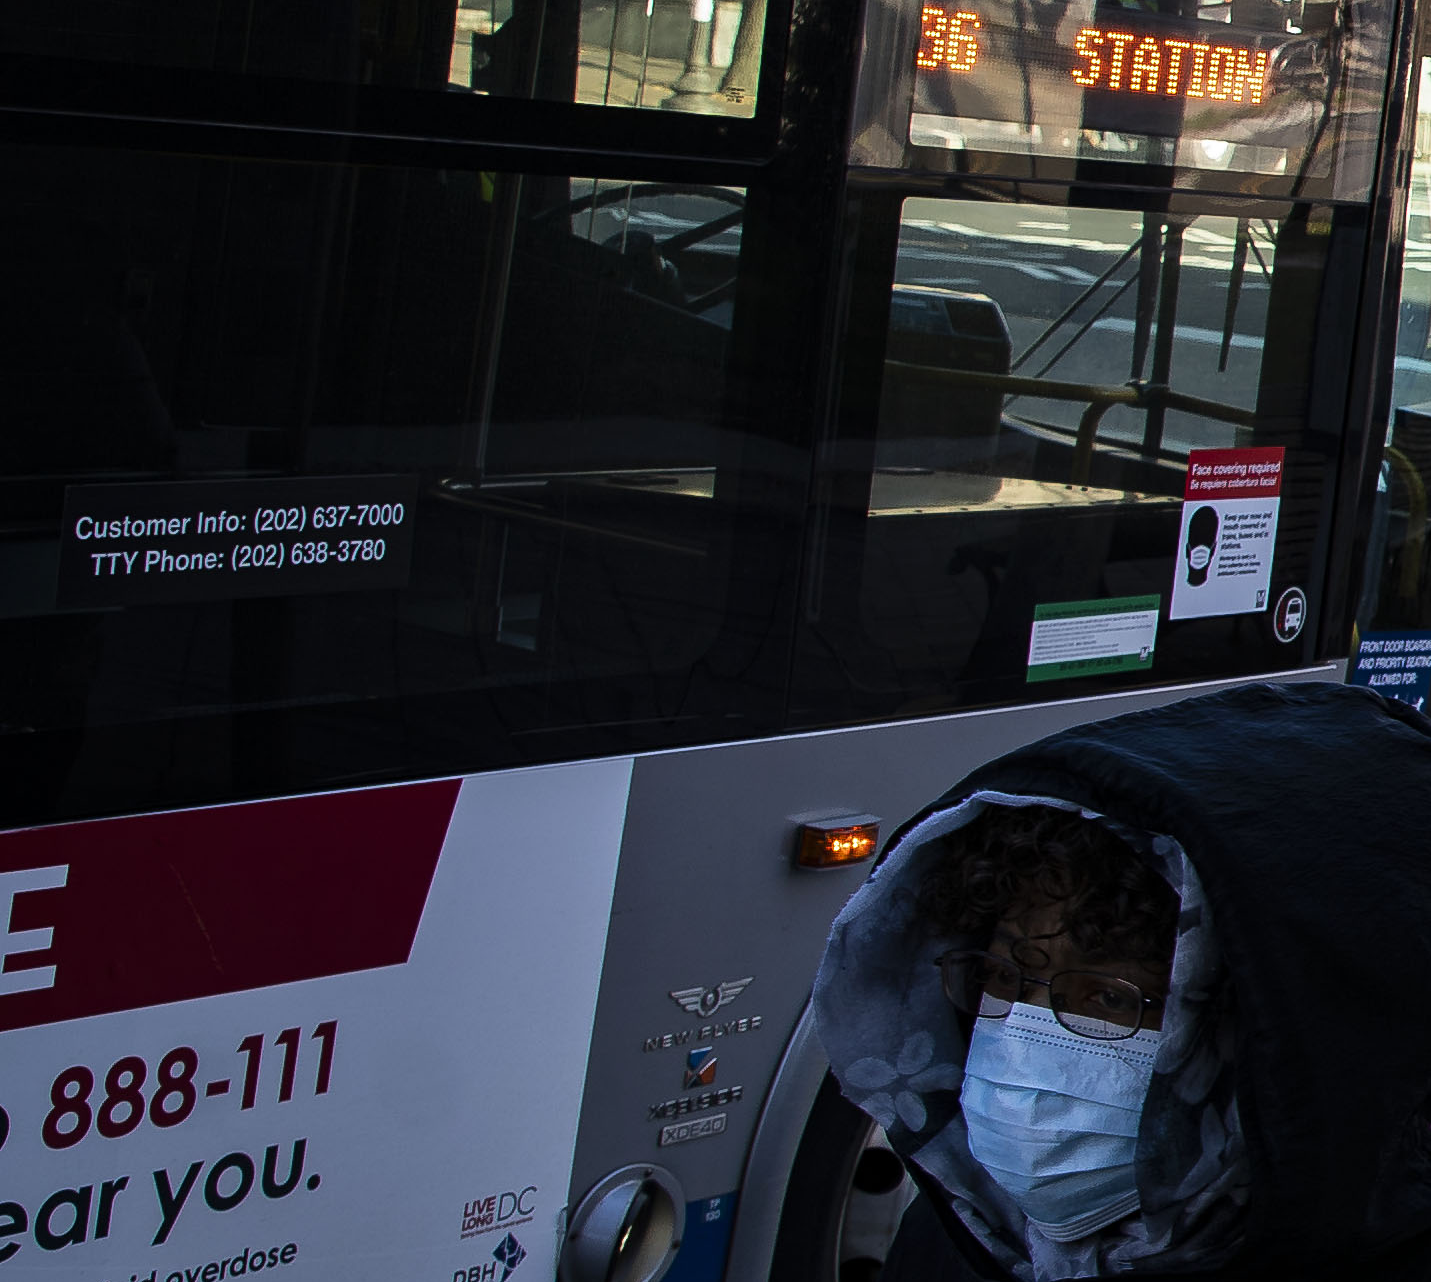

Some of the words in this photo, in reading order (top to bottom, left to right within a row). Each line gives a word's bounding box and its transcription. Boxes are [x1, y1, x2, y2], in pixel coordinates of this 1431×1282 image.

[1072, 27, 1268, 105] STATION
[75, 516, 192, 540] Customer
[197, 511, 247, 535] Info:
[254, 506, 308, 534] (202)
[312, 503, 405, 529] 637-7000
[91, 551, 138, 576] TTY
[144, 549, 224, 573] Phone:
[232, 543, 285, 571] (202)
[291, 539, 386, 565] 638-3780
[643, 1030, 693, 1053] NEW
[699, 1015, 762, 1041] FLYER
[41, 1019, 338, 1150] 888-111
[664, 1118, 724, 1144] XDE40
[151, 1137, 321, 1246] you.
[463, 1195, 498, 1218] LIVE
[497, 1185, 538, 1222] DC
[460, 1213, 496, 1232] LONG
